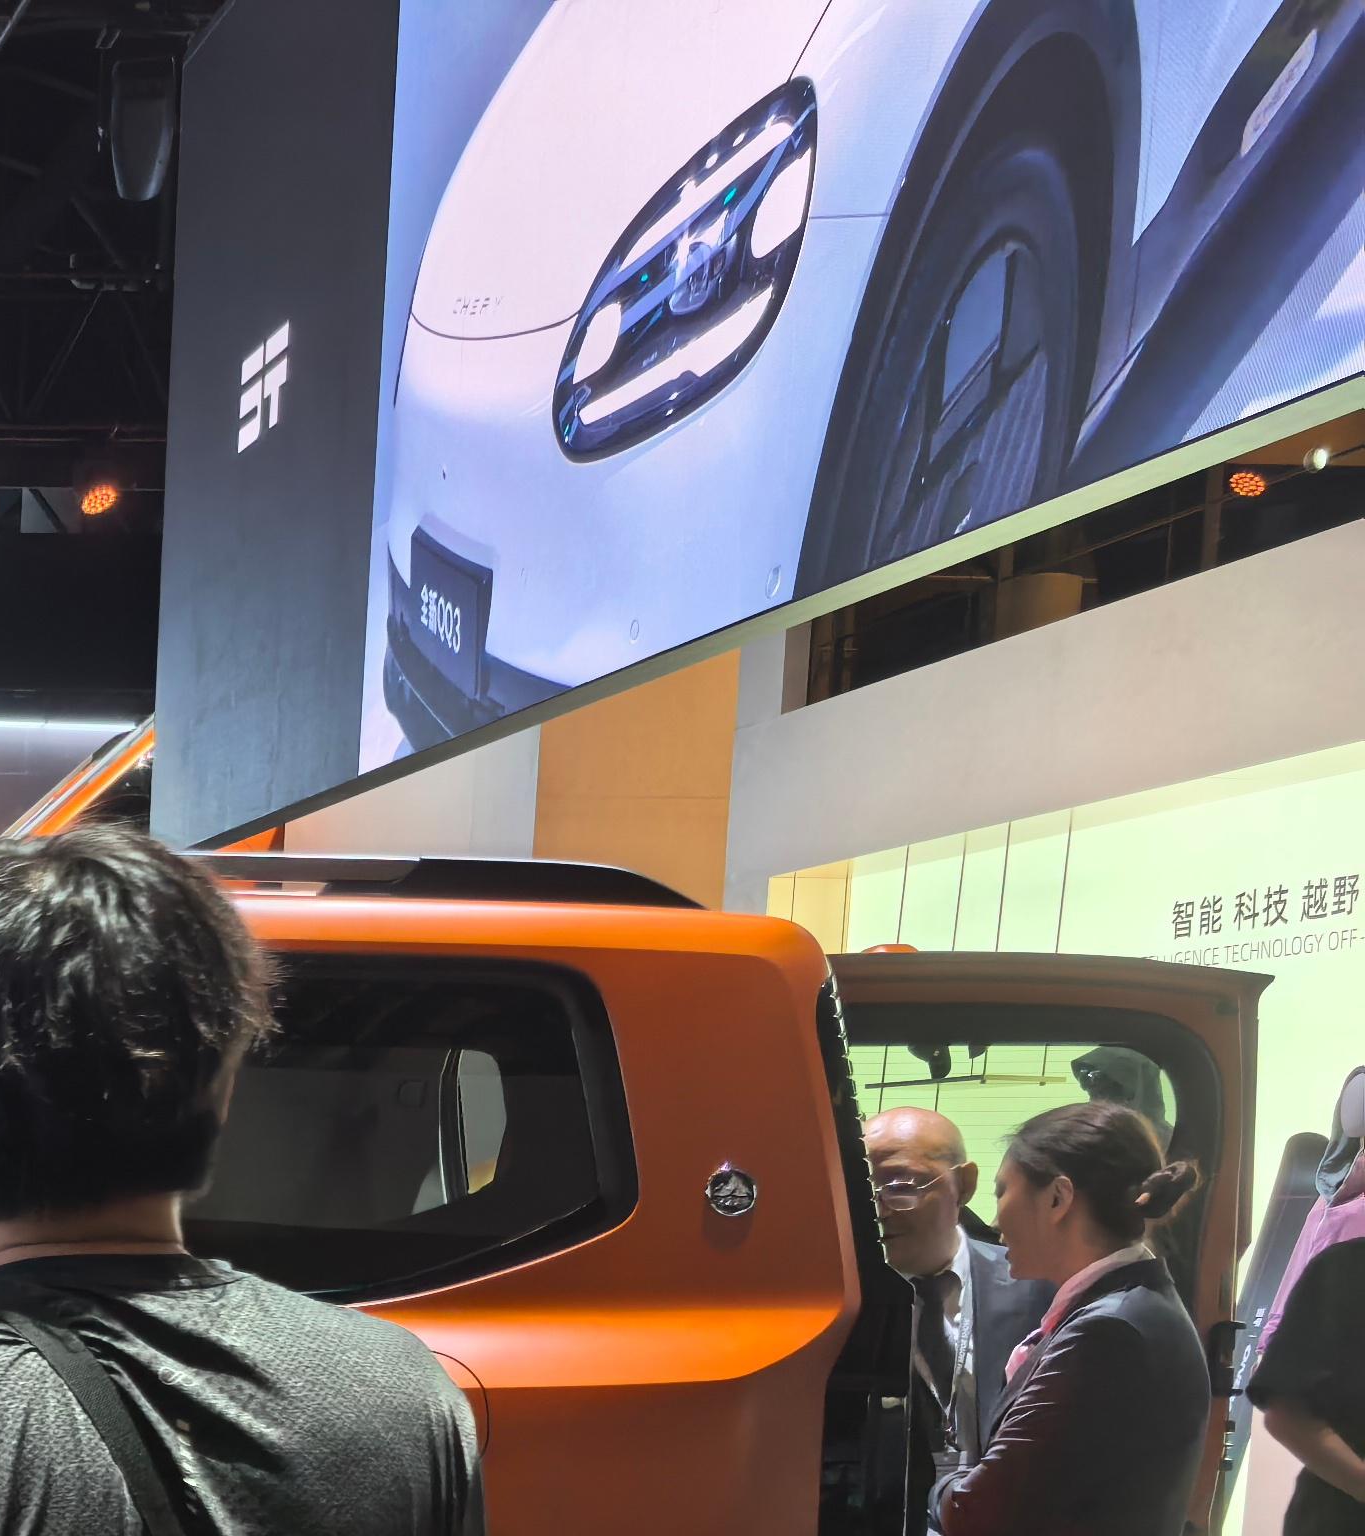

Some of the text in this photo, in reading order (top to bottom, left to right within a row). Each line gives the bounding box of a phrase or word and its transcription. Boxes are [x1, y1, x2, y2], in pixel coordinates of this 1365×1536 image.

[420, 583, 461, 654] 全新QQ3
[1171, 874, 1360, 940] 智能 科技 越野
[1224, 933, 1325, 965] TECHNOLOGY
